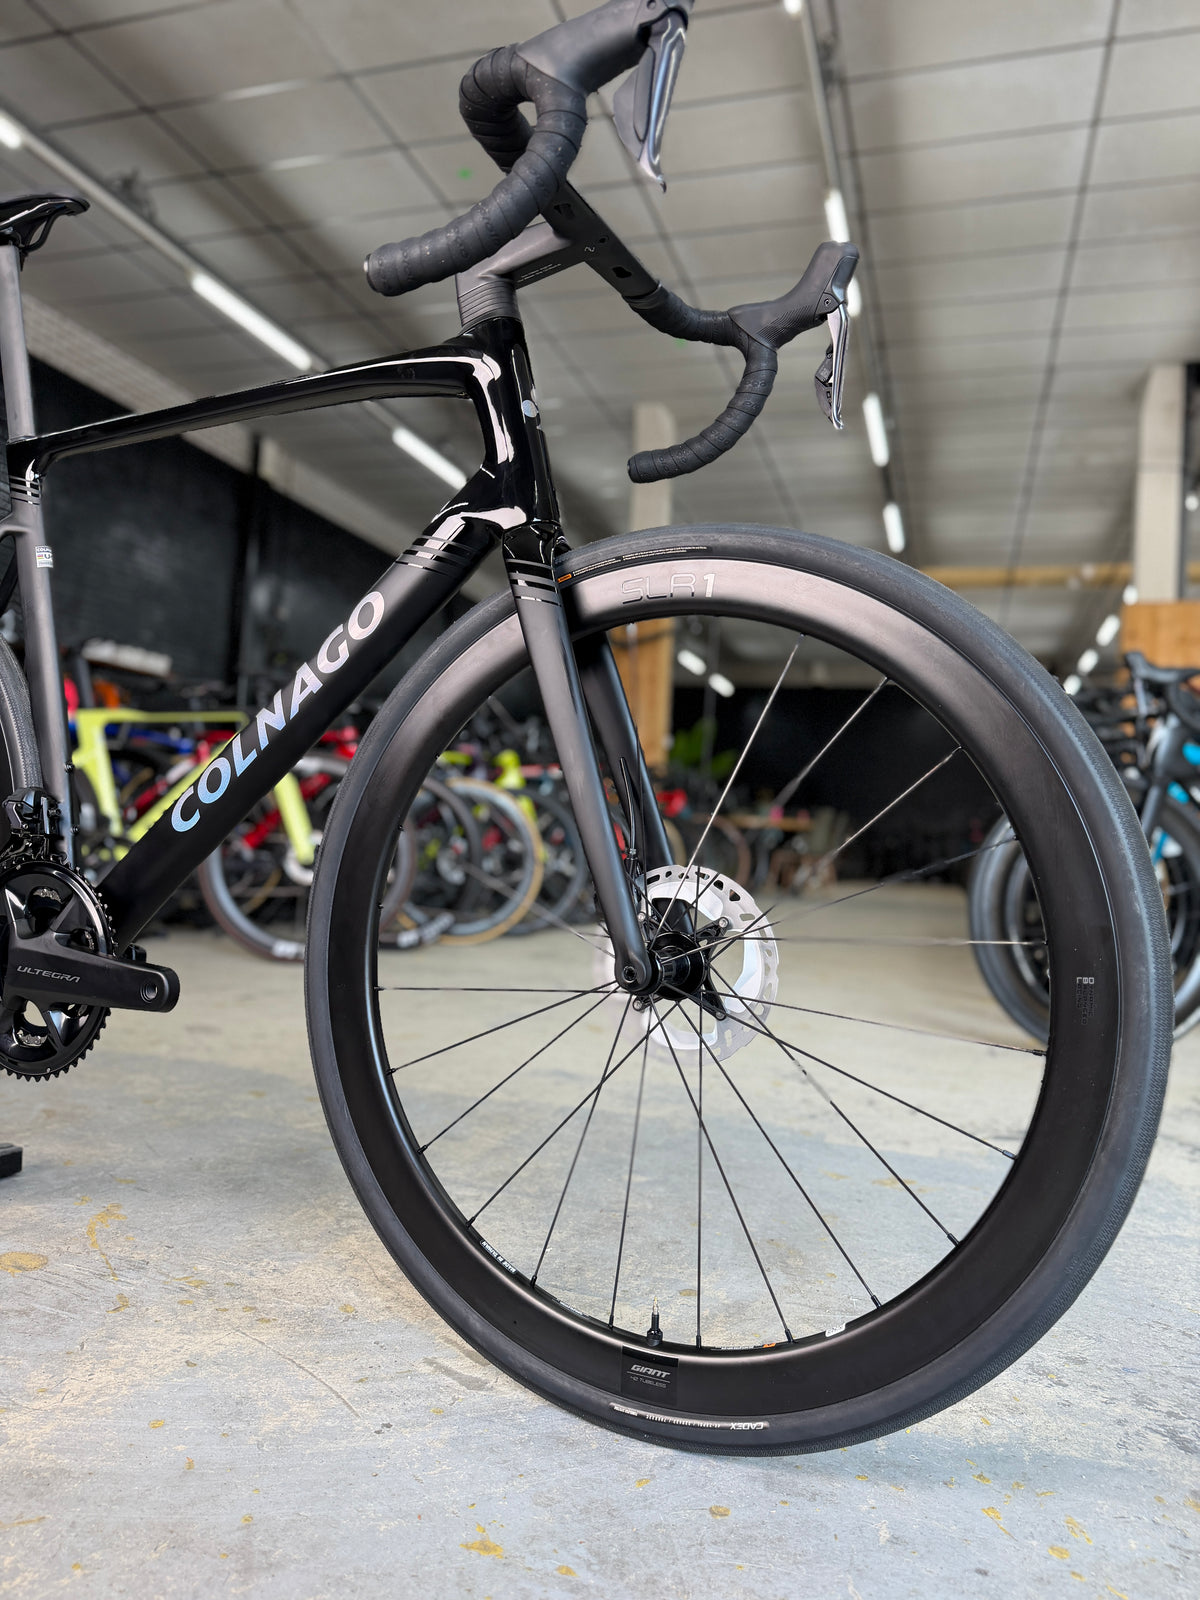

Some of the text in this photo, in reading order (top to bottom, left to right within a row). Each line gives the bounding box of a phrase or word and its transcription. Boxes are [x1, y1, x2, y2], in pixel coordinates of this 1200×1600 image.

[171, 591, 385, 832] COLNAGO
[16, 965, 81, 983] ULTEGRA
[630, 1364, 671, 1378] GIANT
[639, 1377, 667, 1389] TUBELESS
[729, 1422, 764, 1431] CADEX
